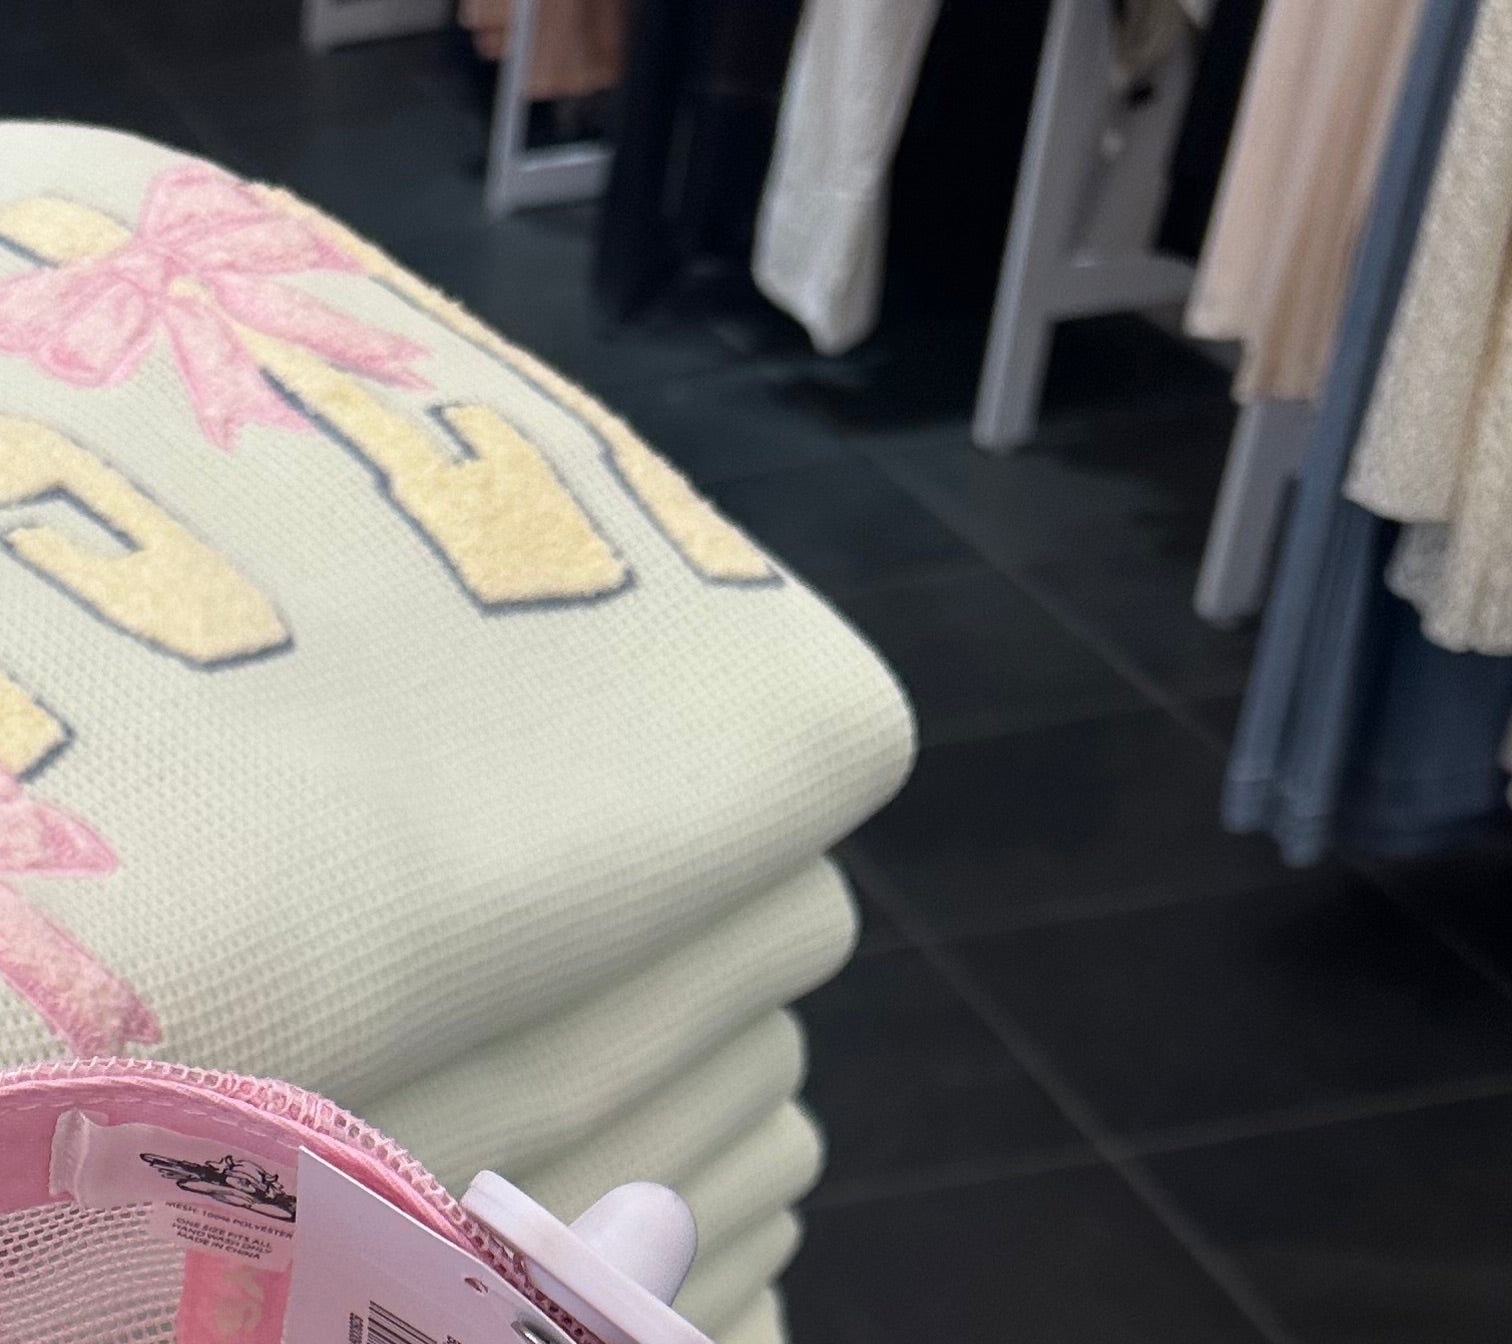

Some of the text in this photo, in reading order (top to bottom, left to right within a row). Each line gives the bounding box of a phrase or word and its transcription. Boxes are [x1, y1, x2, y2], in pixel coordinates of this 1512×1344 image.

[165, 1201, 293, 1239] MESH: 100% POLYESTER
[176, 1217, 272, 1249] ONE SIZE FITS ALL
[172, 1223, 272, 1255] HAND WASH ONLY
[176, 1231, 209, 1246] MADE
[225, 1245, 260, 1260] CHINA
